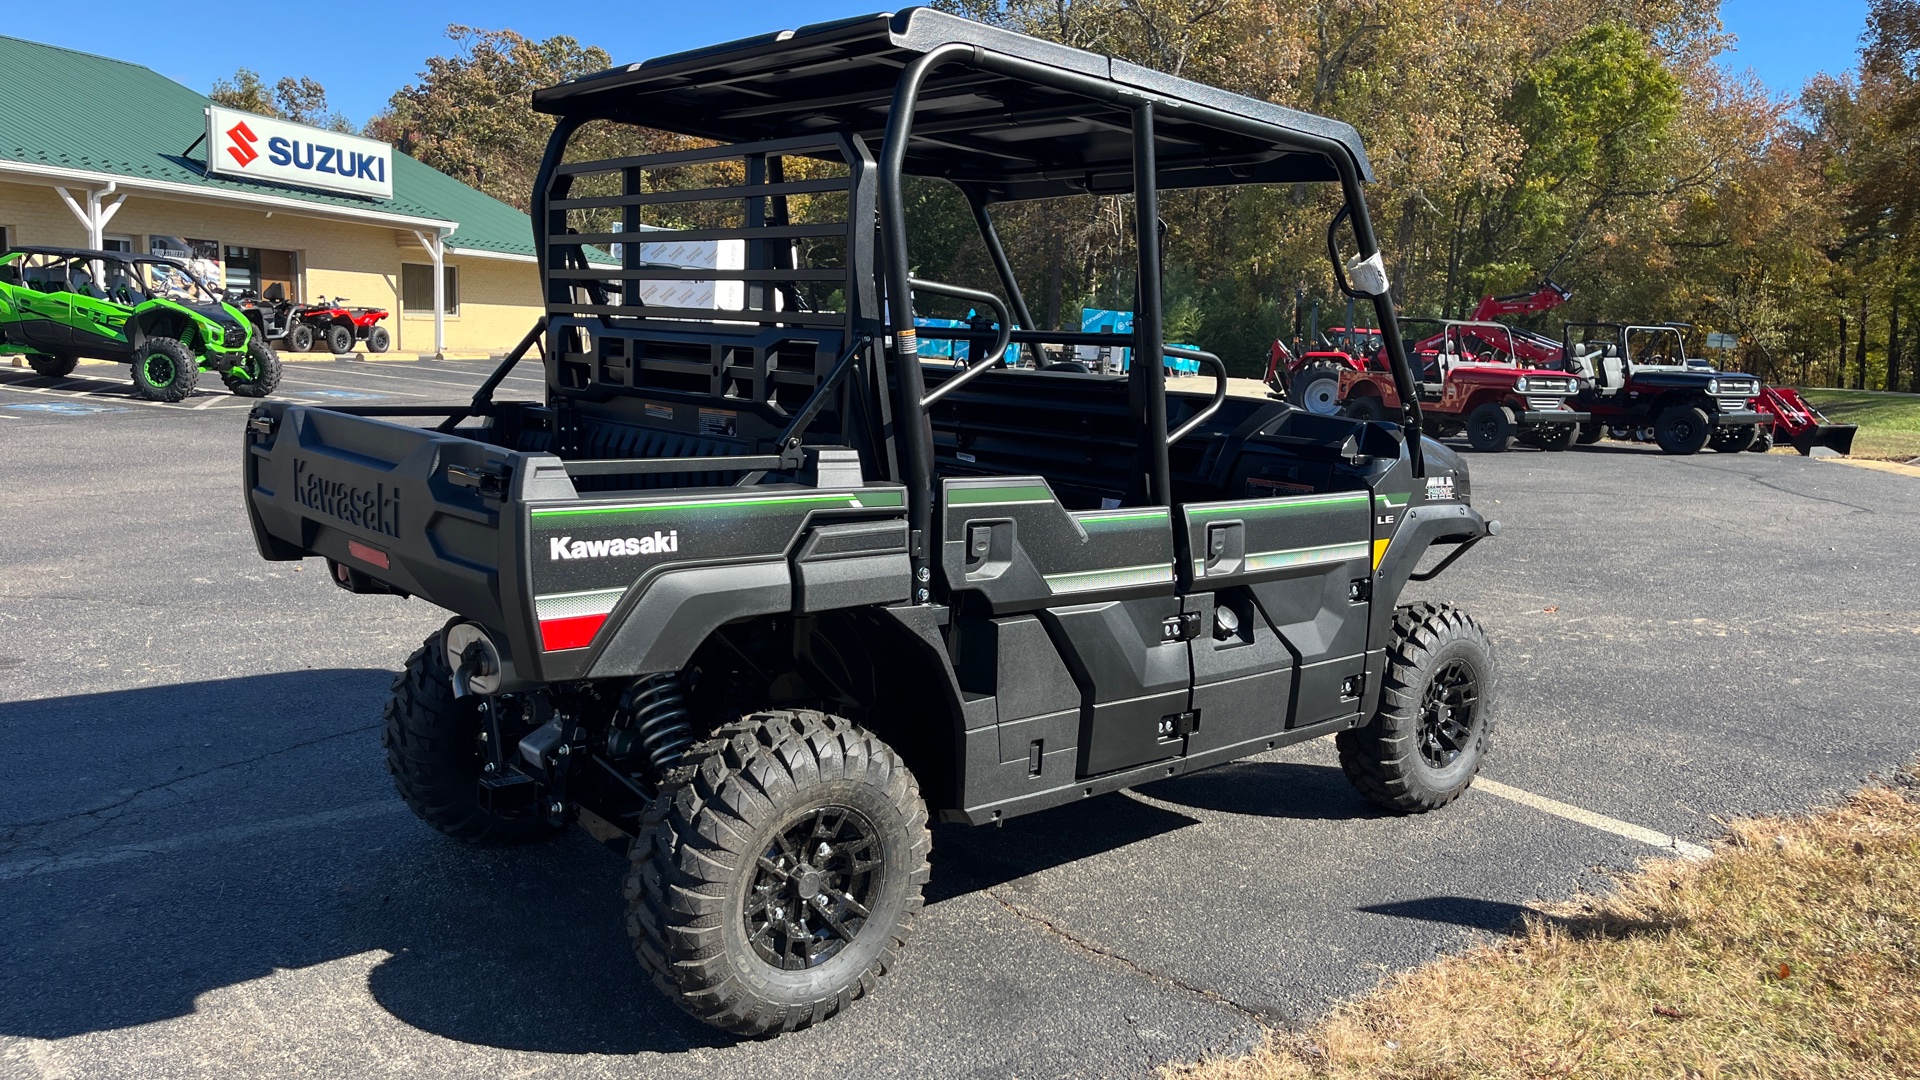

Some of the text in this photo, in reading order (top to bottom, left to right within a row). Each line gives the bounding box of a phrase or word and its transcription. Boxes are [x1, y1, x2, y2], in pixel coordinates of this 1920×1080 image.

[268, 136, 385, 182] SUZUKI
[165, 249, 185, 258] STREETS
[293, 458, 401, 539] Kawasaki
[1377, 515, 1394, 525] LE
[550, 529, 678, 560] Kawasaki
